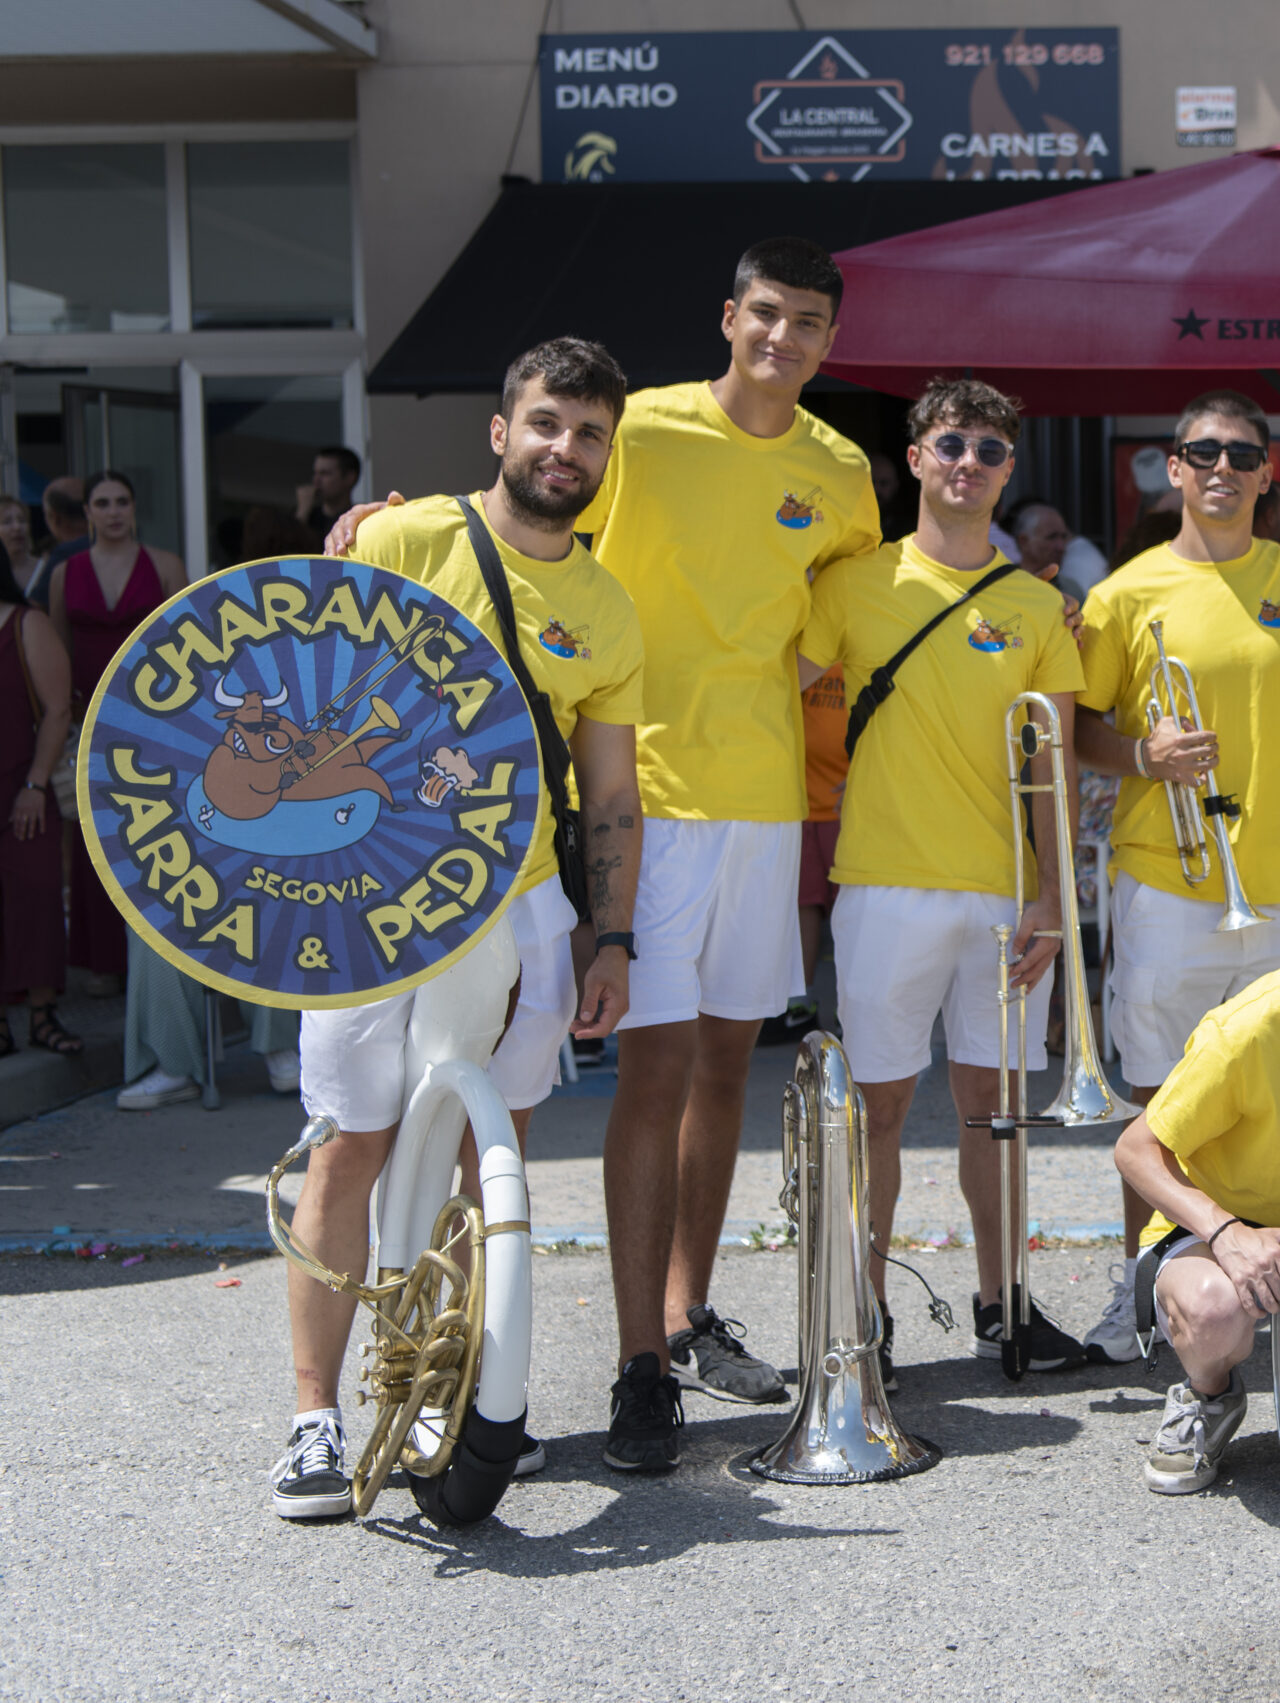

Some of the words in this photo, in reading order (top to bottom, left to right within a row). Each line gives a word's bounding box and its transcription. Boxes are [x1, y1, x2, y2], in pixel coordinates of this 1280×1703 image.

[554, 41, 659, 73] MENÚ
[945, 44, 991, 66] 921
[1003, 44, 1049, 65] 129
[1053, 43, 1104, 65] 668
[555, 82, 678, 109] DIARIO
[779, 108, 802, 125] LA
[804, 107, 879, 125] CENTRAL
[941, 132, 1079, 157] CARNES
[1083, 131, 1108, 156] A
[132, 580, 496, 732] CHARANGA
[109, 746, 255, 962] JARRA
[297, 936, 331, 970] &
[365, 761, 517, 965] PEDAL
[243, 865, 384, 906] SEGOVIA
